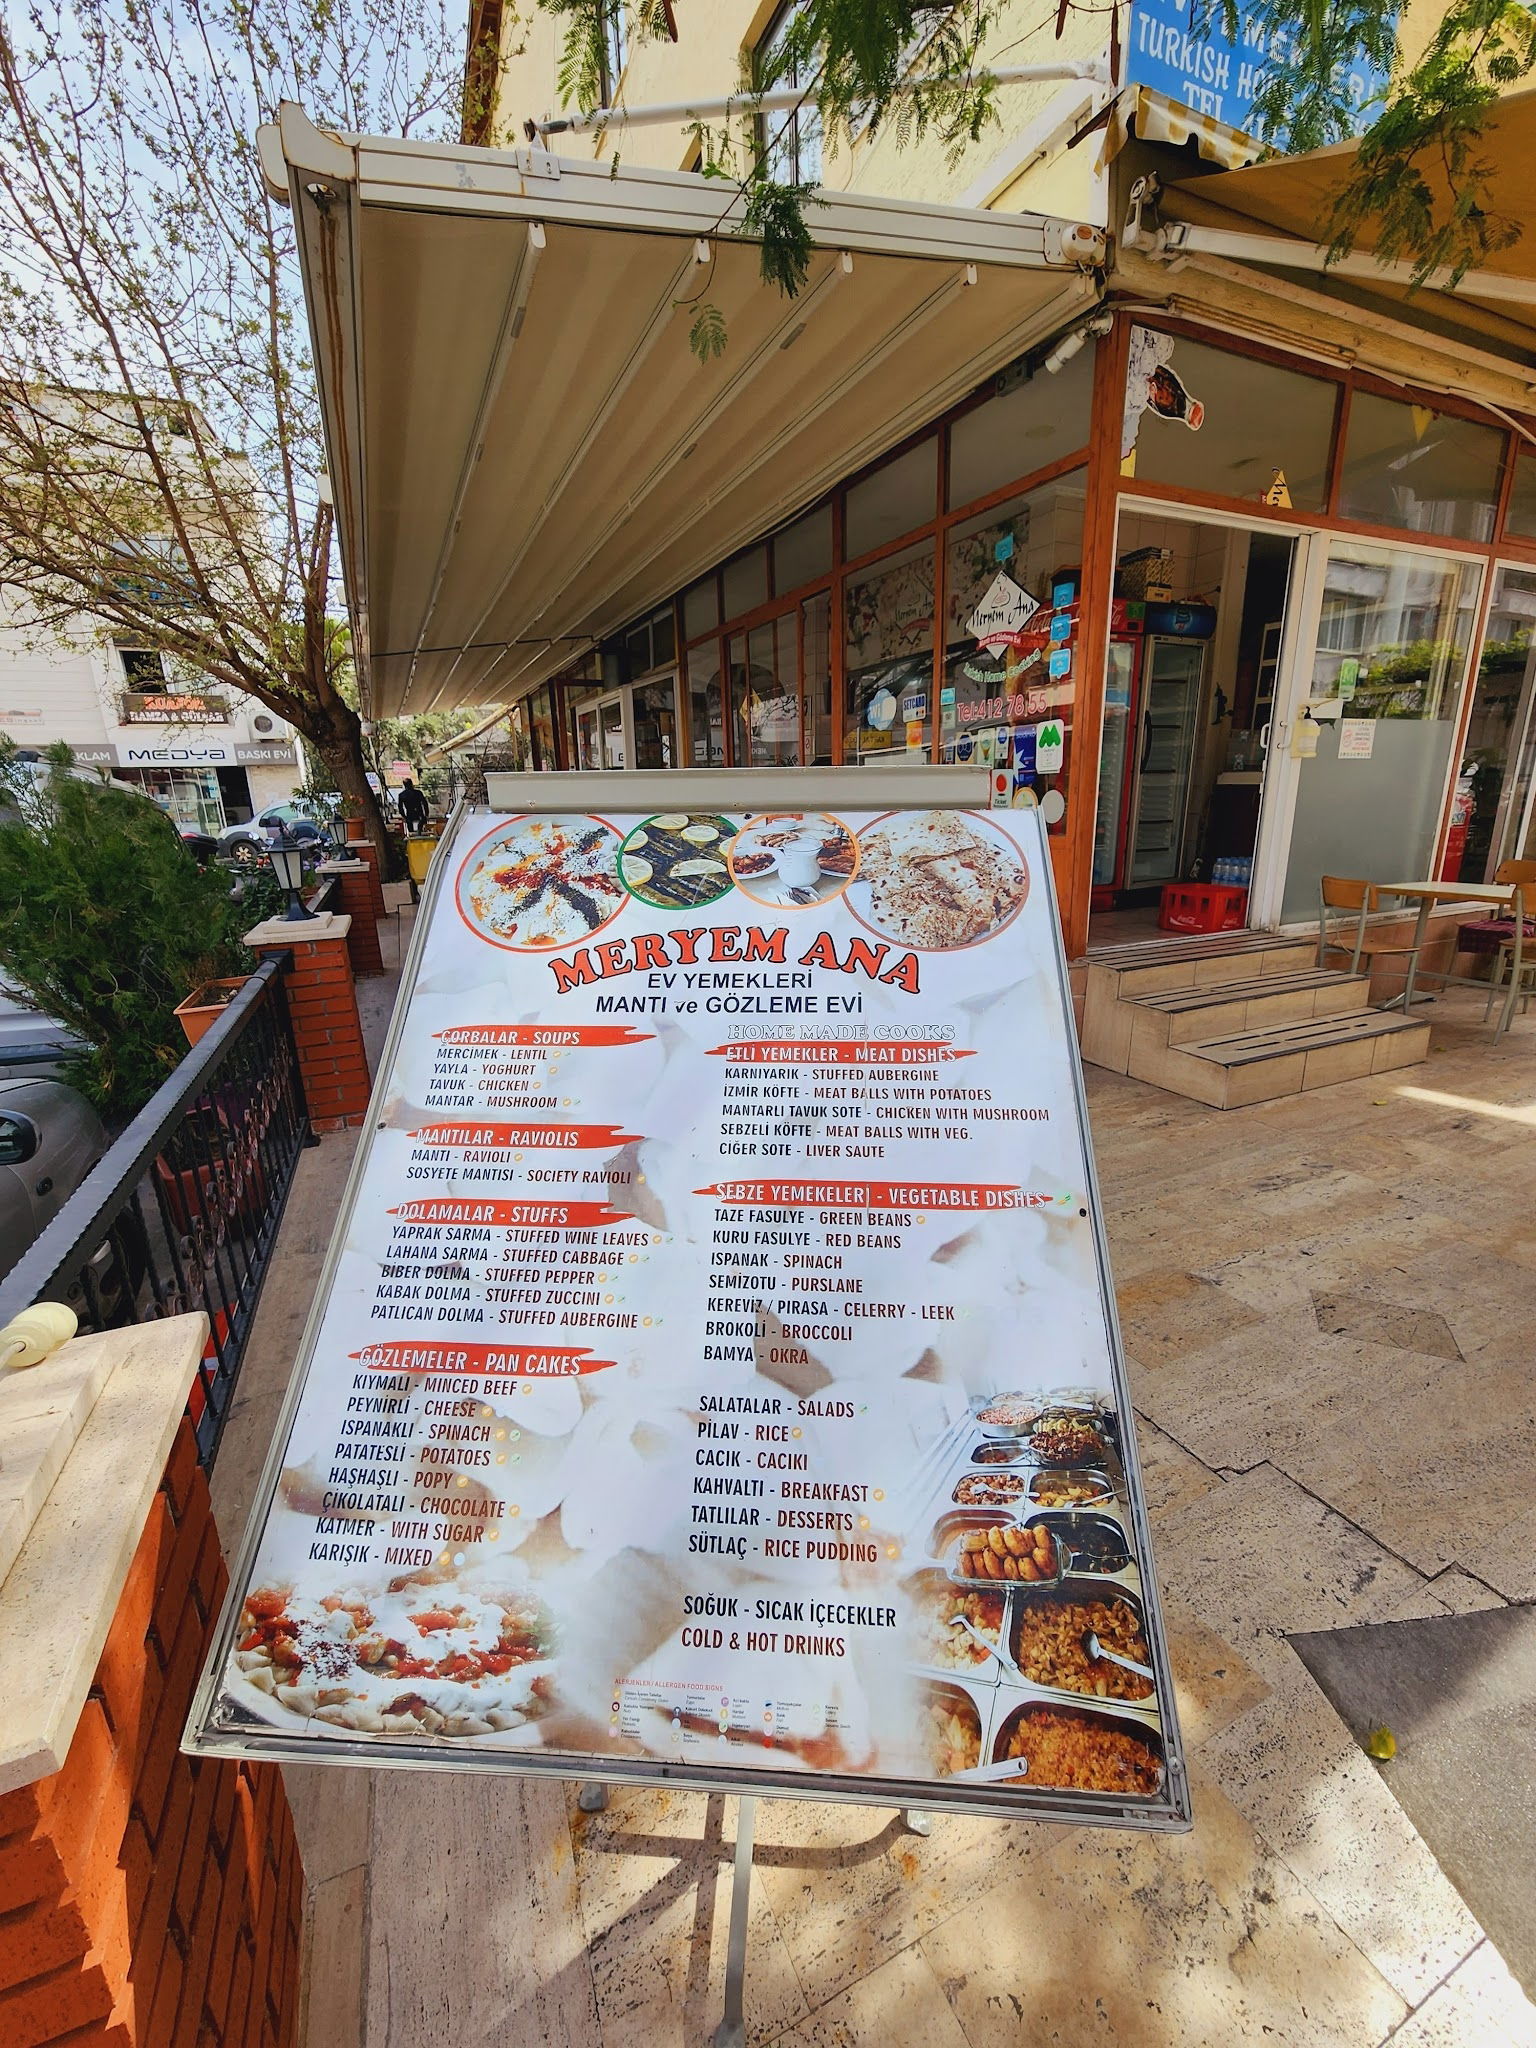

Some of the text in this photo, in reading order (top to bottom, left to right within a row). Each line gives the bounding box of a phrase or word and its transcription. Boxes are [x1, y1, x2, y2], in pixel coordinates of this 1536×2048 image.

[1138, 12, 1230, 90] TURKISH
[73, 751, 111, 762] KLAM
[237, 748, 291, 760] BASKI EVİ
[548, 926, 921, 995] MERYEM ANA
[648, 969, 812, 989] EV YEMEKLERİ
[596, 991, 863, 1013] MANTI ve GÖZLEME EVİ
[532, 1031, 580, 1045] SOUPS
[728, 1024, 956, 1040] HOME MADE COOKS
[437, 1047, 547, 1060] MERCİMEK LENTIL
[726, 1043, 956, 1063] ETLİ YEMEKLER MEAT DISHES
[434, 1063, 536, 1075] YAYLA YOGHURT
[725, 1068, 939, 1082] KARNIYARIK STUFFED AUBERGINE
[430, 1079, 529, 1091] TAVUK CHICKEN
[723, 1084, 992, 1101] İZMİR KÖFTE MEAT BALLS WITH POTATOES
[425, 1095, 557, 1108] MANTAR MUSHROOM
[722, 1104, 1050, 1121] MANTARLI TAVUK SOTE CHICKEN WITH MUSHROOM
[416, 1129, 579, 1147] MANTILAR RAVIOLIS
[411, 1150, 511, 1163] MANTI RAVIOLI
[719, 1140, 885, 1158] CİĞER SOTE LIVER SAUTE
[406, 1167, 631, 1184] SOSYETE MANTISI SOCIETY RAVIOLI
[716, 1184, 765, 1201] SEBZE
[889, 1188, 980, 1206] VEGETABLE
[985, 1190, 1046, 1208] DISHES
[397, 1203, 569, 1223] DOLAMALAR STUFFS
[714, 1209, 912, 1227] TAZE FASULYE GREEN BEANS
[392, 1226, 649, 1247] YAPRAK SARMA STUFFED WINE LEAVES
[386, 1245, 625, 1265] LAHANA SARMA STUFFED CABBAGE
[711, 1252, 843, 1269] ISPANAK SPINACH
[709, 1272, 863, 1293] SEMİZOTU PURSLANE
[371, 1305, 638, 1328] PATLICAN DOLMA STUFFED AUBERGINE
[707, 1296, 955, 1320] KEREVİZ PIRASA CELERRY LEEK
[705, 1319, 853, 1341] BROKOLİ BROCCOLI
[359, 1343, 581, 1375] GÖZLEMELER PAN CAKES
[703, 1345, 809, 1364] BAMYA OKRA
[352, 1374, 518, 1396] KIYMALI MINCED BEEF
[346, 1395, 477, 1417] PEYNİRLİ CHEESE
[699, 1395, 855, 1418] SALATALAR SALADS
[340, 1419, 491, 1442] ISPANAKLI SPINACH
[697, 1418, 789, 1442] PİLAV RICE
[335, 1442, 491, 1466] PATATESLİ POTATOES
[695, 1449, 808, 1470] CACIK CACIKI
[328, 1467, 454, 1490] HAŞHAŞLI POPY
[693, 1476, 869, 1502] KAHVALTI BREAKFAST
[321, 1488, 506, 1518] ÇİKOLATALI CHOCOLATE
[691, 1505, 853, 1531] TATLILAR DESSERTS
[308, 1542, 433, 1567] KARIŞIK MIXED
[688, 1530, 878, 1563] SÜTLAÇ RICE PUDDING
[683, 1592, 896, 1628] SOĞUK SICAK İÇECEKLER
[681, 1627, 845, 1657] COLD & HOT DRINKS
